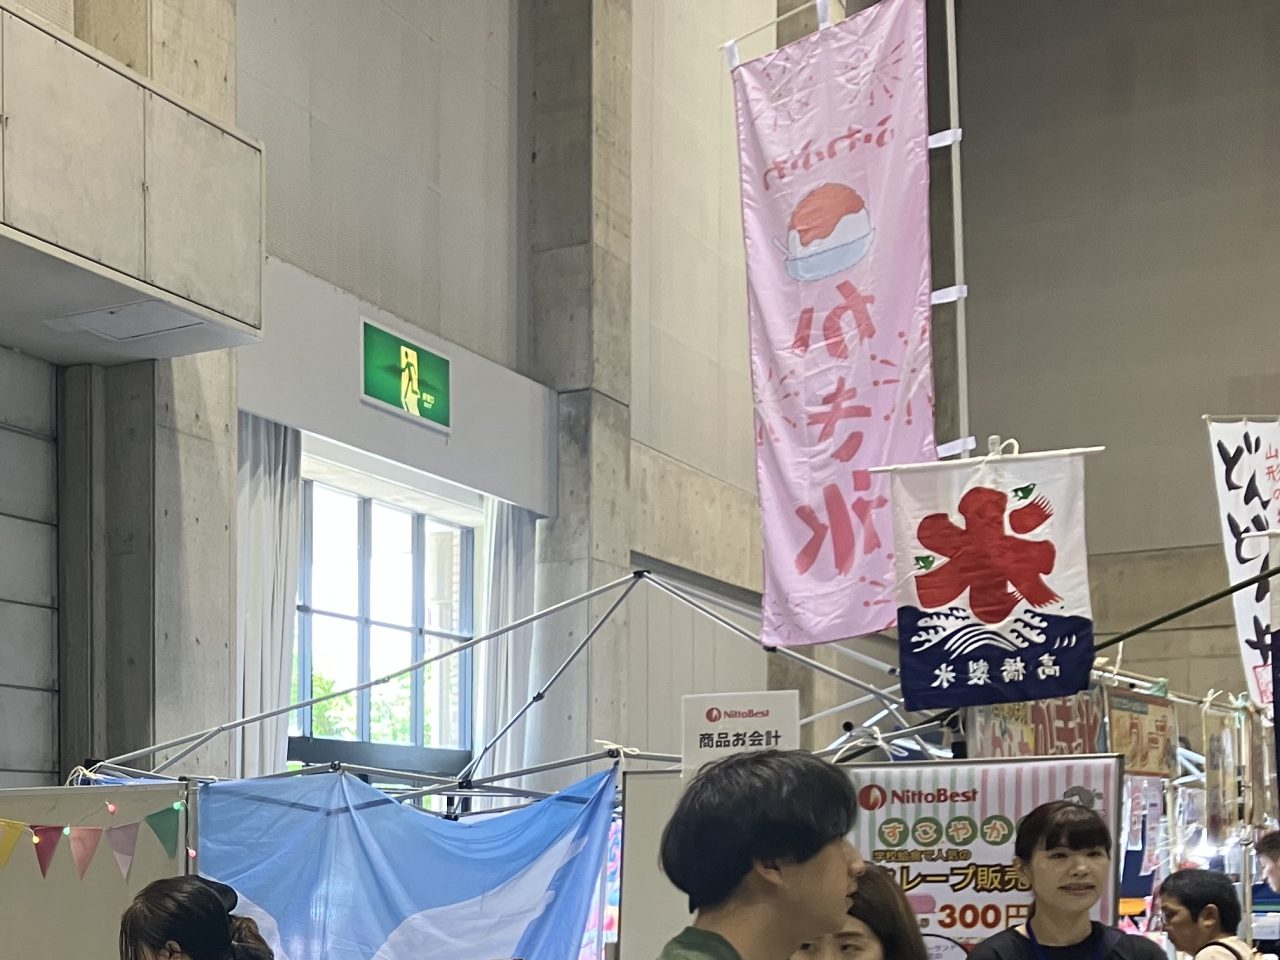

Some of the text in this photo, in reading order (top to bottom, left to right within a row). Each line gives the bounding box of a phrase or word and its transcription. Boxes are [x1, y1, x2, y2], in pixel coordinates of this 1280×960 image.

[723, 709, 770, 719] NittoBest
[699, 730, 781, 748] 商品お会計
[891, 788, 979, 804] NittoBest
[880, 818, 1010, 845] すこやか
[873, 849, 972, 863] 学校給食で人気の
[892, 864, 1033, 893] レープ販売
